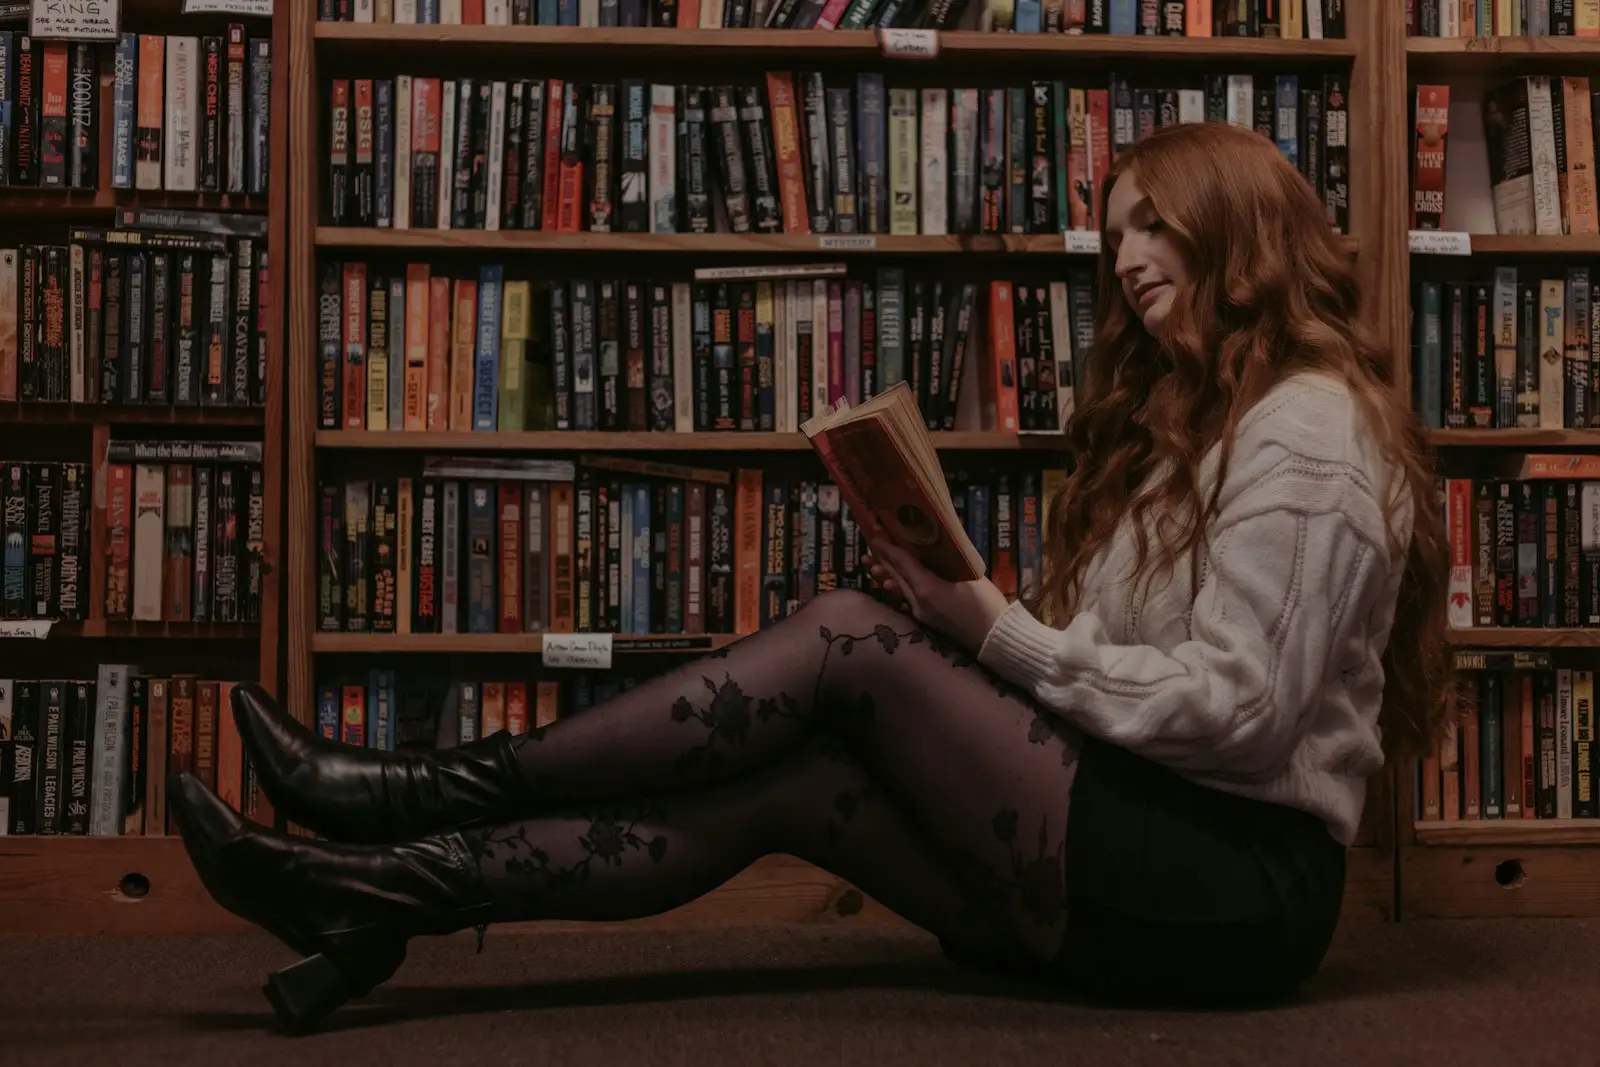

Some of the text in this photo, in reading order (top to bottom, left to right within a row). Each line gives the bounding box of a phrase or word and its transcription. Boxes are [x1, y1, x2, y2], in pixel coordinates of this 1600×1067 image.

[47, 2, 101, 15] KING
[20, 53, 33, 107] DEAN KOONTZ
[115, 52, 125, 89] KOONTZ
[124, 59, 133, 85] DEAN
[206, 52, 218, 117] NIGHT CHILLS
[72, 73, 91, 126] KOONTZ
[117, 119, 128, 167] THE MASK
[23, 259, 32, 288] PATRICK
[880, 307, 901, 348] KEEPER
[1501, 312, 1513, 345] JANCE
[235, 315, 249, 390] SCAVENGER
[407, 382, 418, 416] SENTRY
[478, 358, 493, 416] SUSPECT
[4, 496, 15, 528] SAUL
[13, 496, 25, 525] JOHN
[36, 485, 53, 533] JOHN SAUL
[61, 489, 80, 549] NATHANIEL
[249, 493, 263, 519] JOHN
[1496, 499, 1506, 546] KELMAN
[1503, 502, 1514, 545] JUDITH
[1478, 512, 1492, 583] Judith Kelman
[60, 551, 78, 612] JOHN SAUL
[216, 554, 236, 602] SHADOWS
[418, 566, 435, 617] HOSTAGE
[13, 627, 37, 638] Saul
[47, 713, 59, 737] PAUL
[103, 722, 117, 752] WILSON
[1559, 689, 1571, 754] Elmore Leonard
[13, 744, 33, 784] REBORN
[46, 736, 58, 770] WILSON
[72, 747, 86, 766] PAUL
[43, 775, 57, 819] LEGACIES
[71, 766, 86, 797] WILSON
